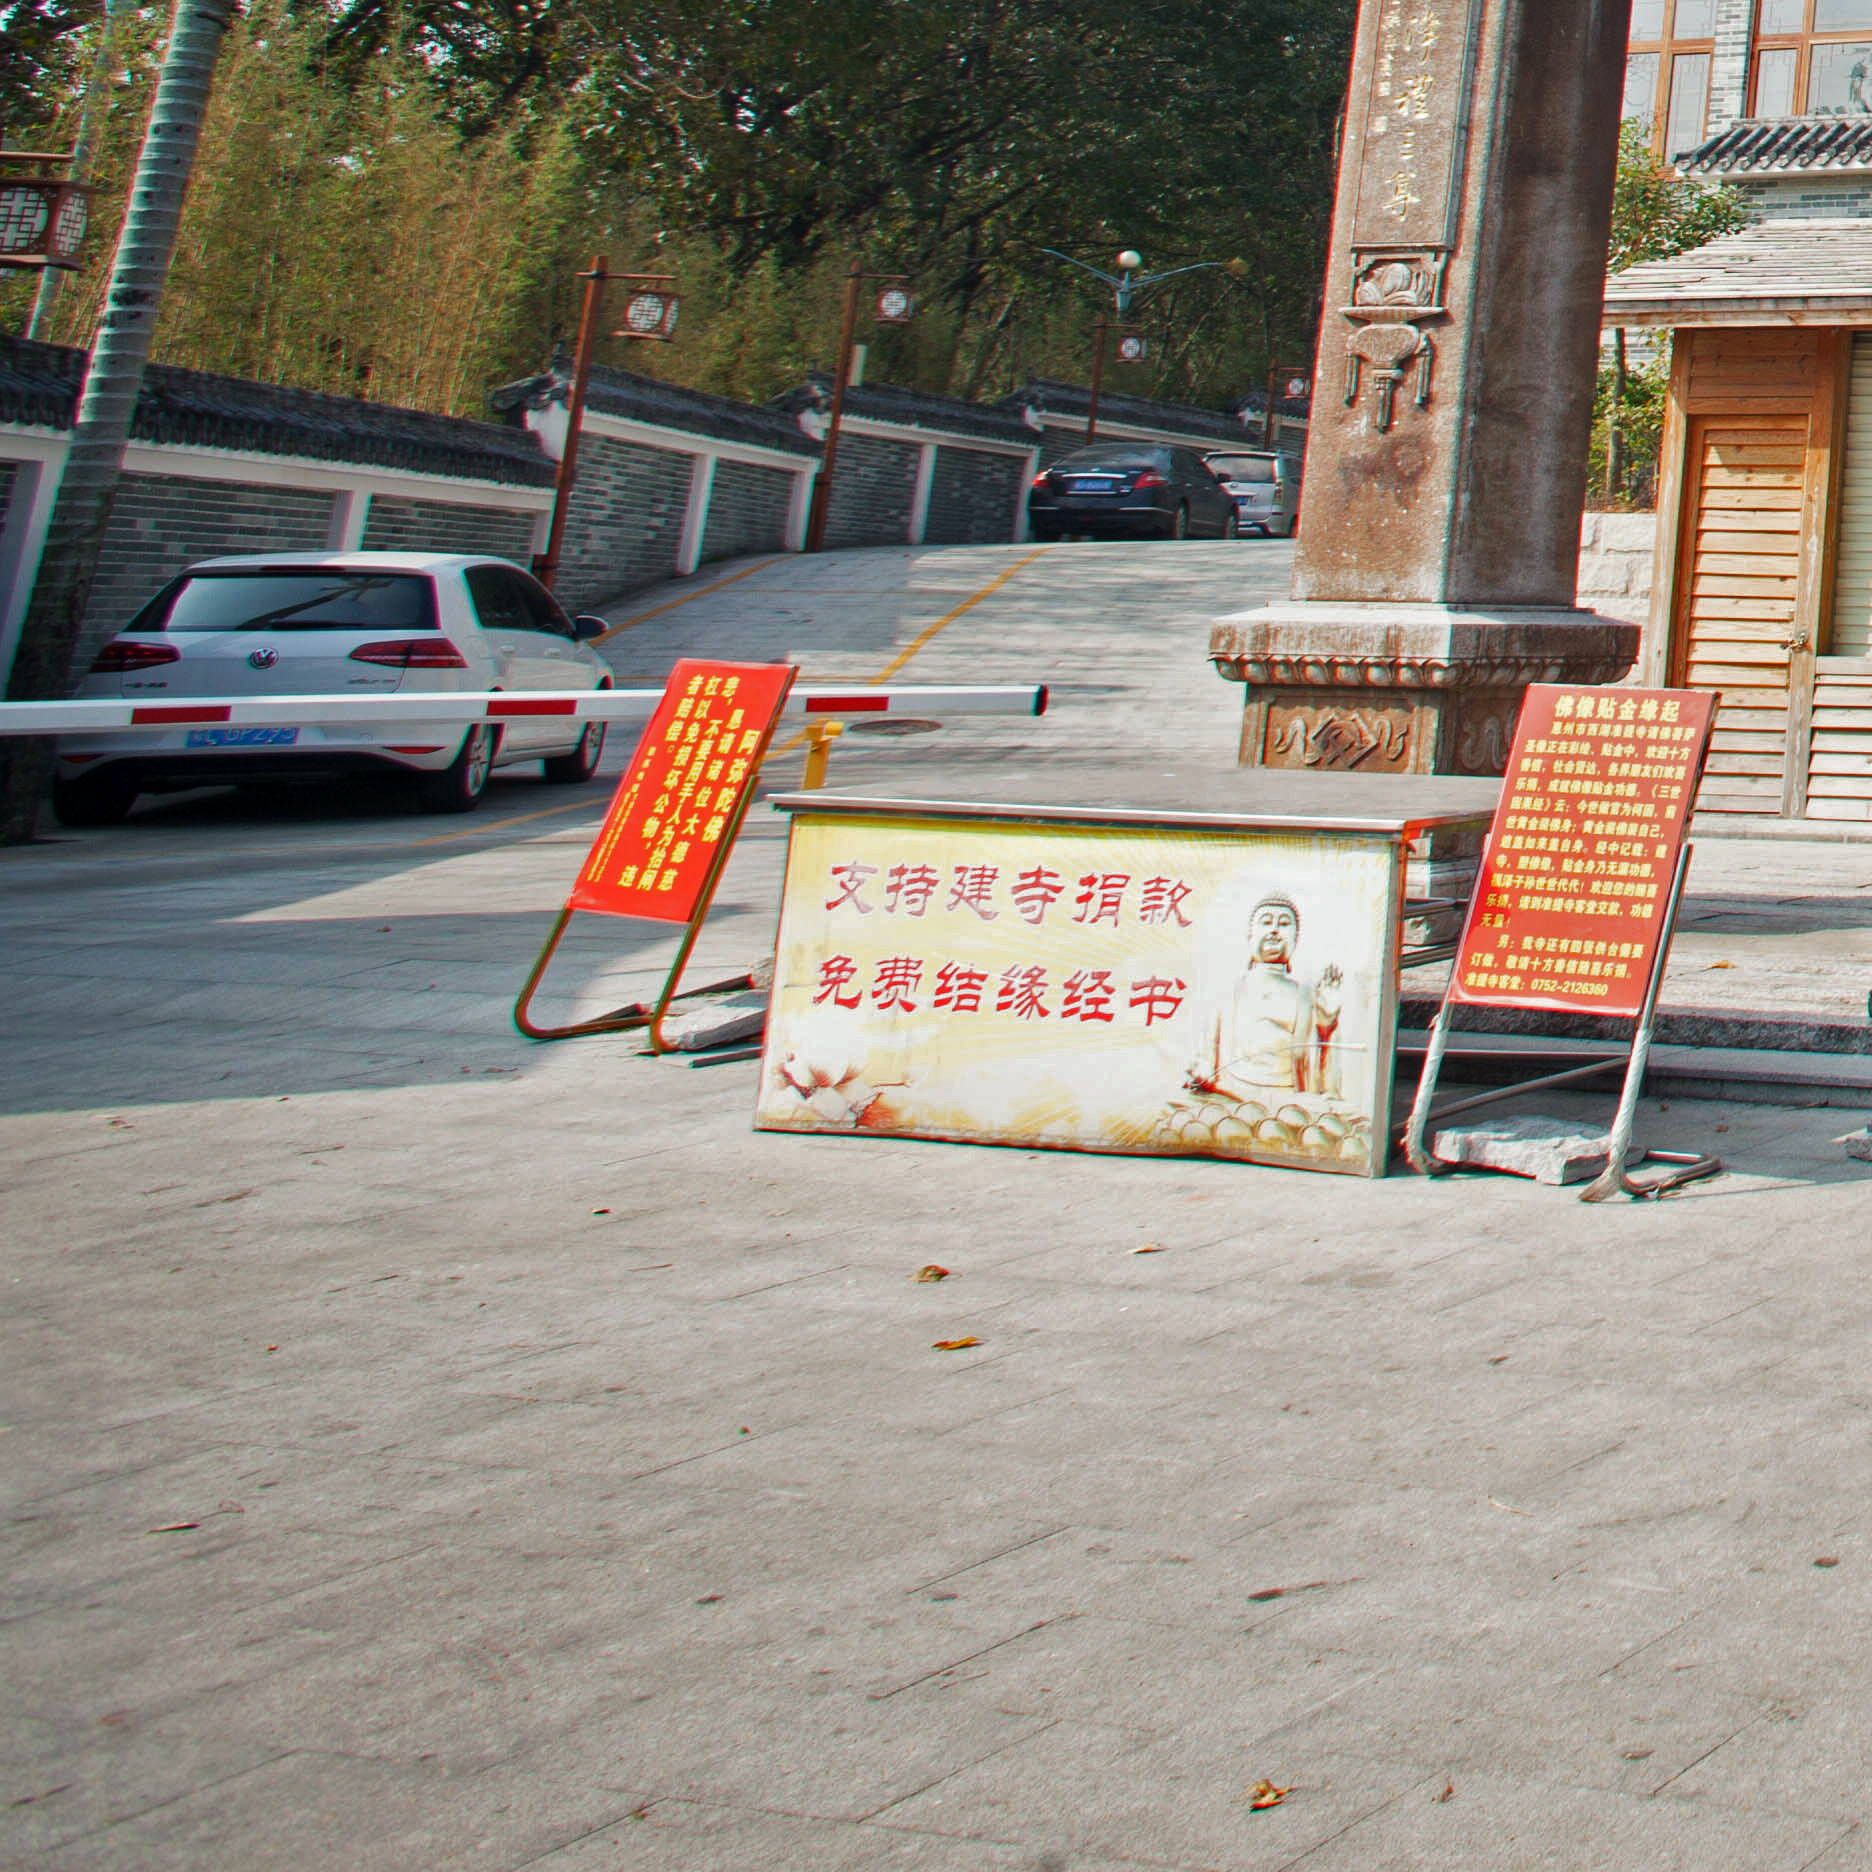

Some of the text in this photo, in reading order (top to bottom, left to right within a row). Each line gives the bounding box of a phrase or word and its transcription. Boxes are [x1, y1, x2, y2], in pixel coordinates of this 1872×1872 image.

[825, 860, 1193, 928] 支持建寺捐款
[811, 954, 1188, 1027] 免费结缘经书
